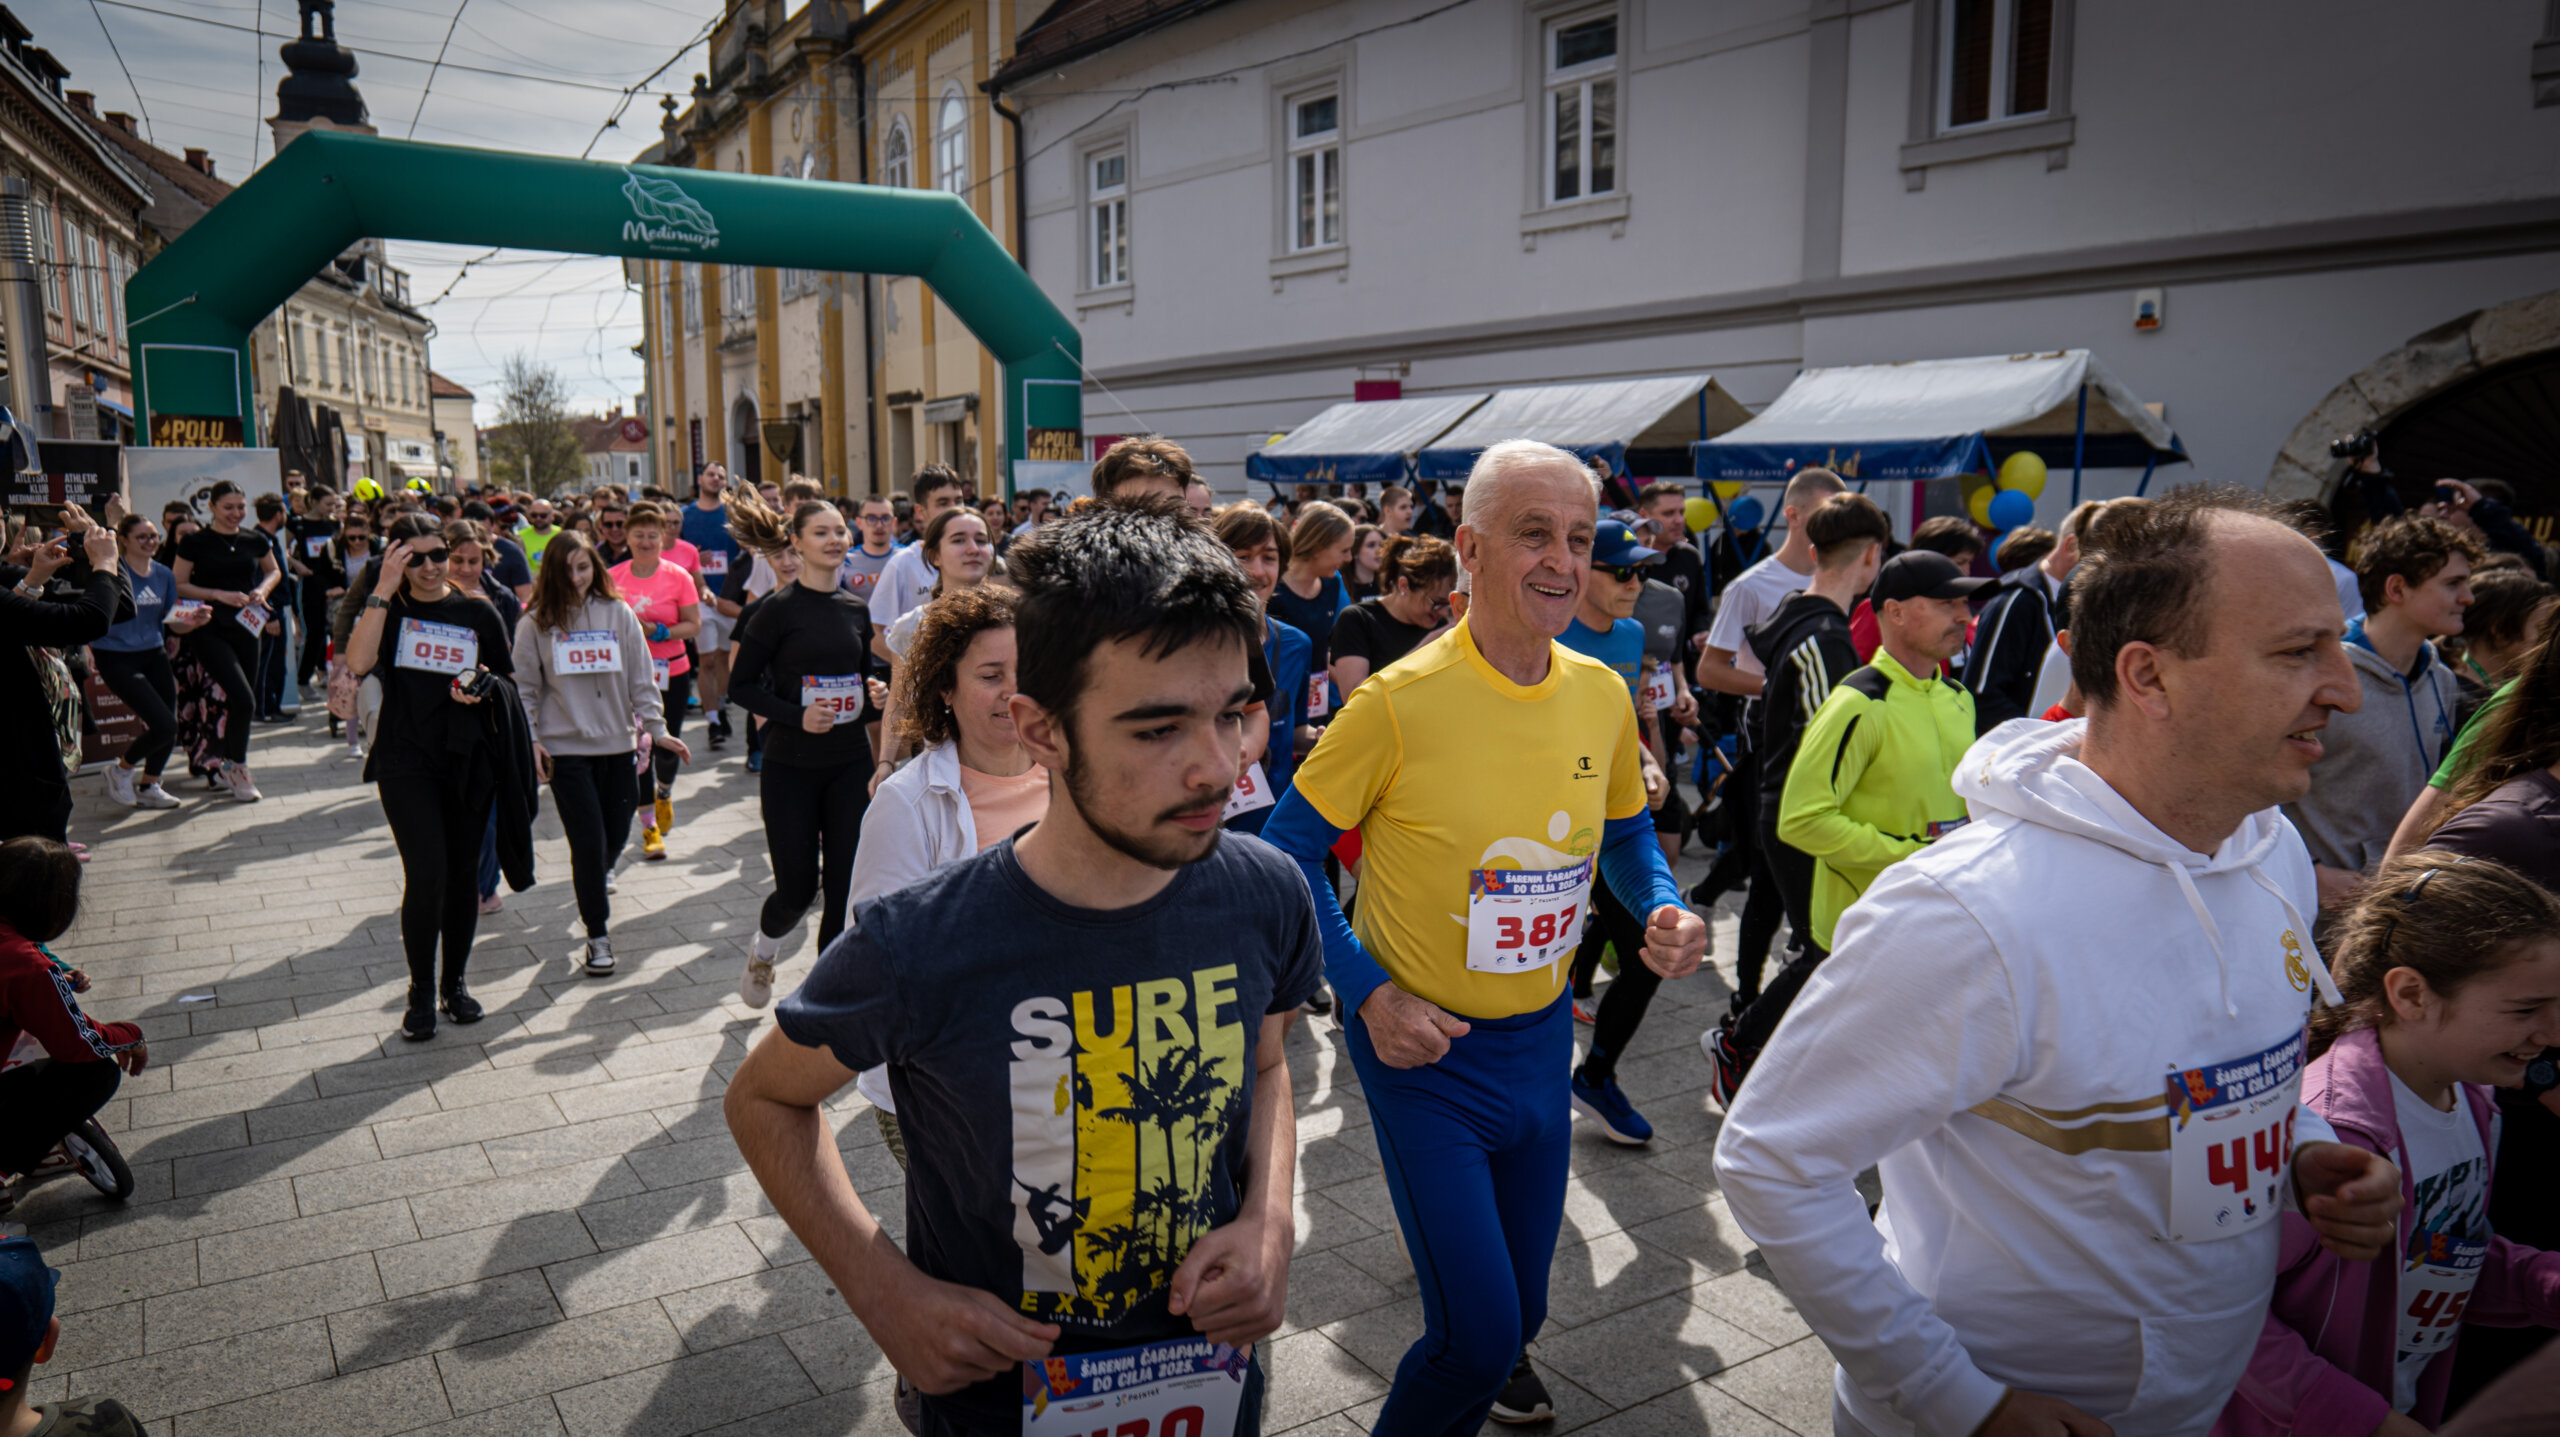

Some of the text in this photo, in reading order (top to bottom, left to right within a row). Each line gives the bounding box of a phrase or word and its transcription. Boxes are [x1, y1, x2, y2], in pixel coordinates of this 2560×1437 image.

[172, 419, 224, 441] POLU
[1043, 431, 1076, 448] POLU
[64, 473, 98, 484] ATHLETIC
[29, 483, 49, 494] KLUB
[64, 483, 85, 494] CLUB
[414, 641, 464, 664] 055
[569, 648, 611, 664] 054
[1505, 871, 1543, 883] ŠARENIM
[1513, 884, 1527, 894] DO
[1530, 883, 1555, 894] CILJA
[1496, 903, 1578, 949] 387
[54, 971, 76, 1007] ZOE
[2227, 1082, 2245, 1101] DO
[1020, 1269, 1166, 1319] EXTRE
[1080, 1342, 1213, 1379] ŠARENIM ČARAPAMA
[1092, 1376, 1113, 1394] DO
[1116, 1368, 1153, 1388] CILJA
